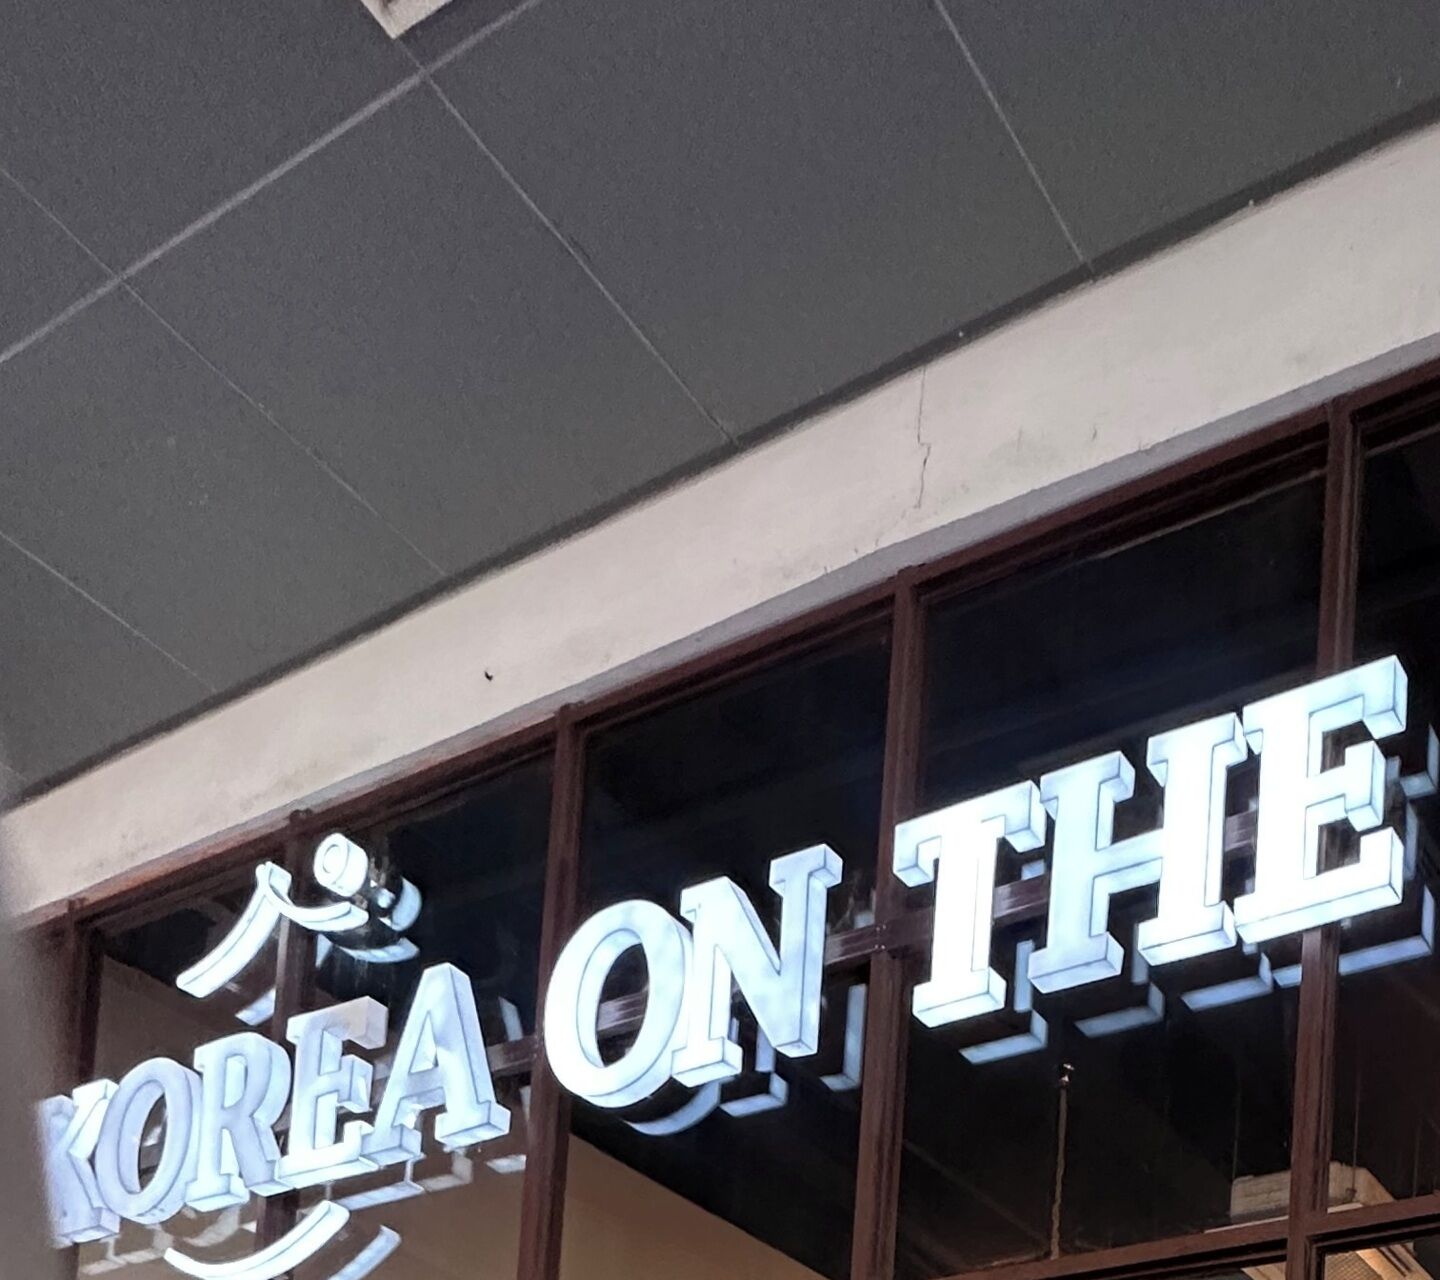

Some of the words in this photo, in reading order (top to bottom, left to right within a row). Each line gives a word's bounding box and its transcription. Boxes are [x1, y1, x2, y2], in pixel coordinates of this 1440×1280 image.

[39, 962, 511, 1247] KOREA
[543, 843, 843, 1108] ON
[893, 655, 1408, 1028] THE
